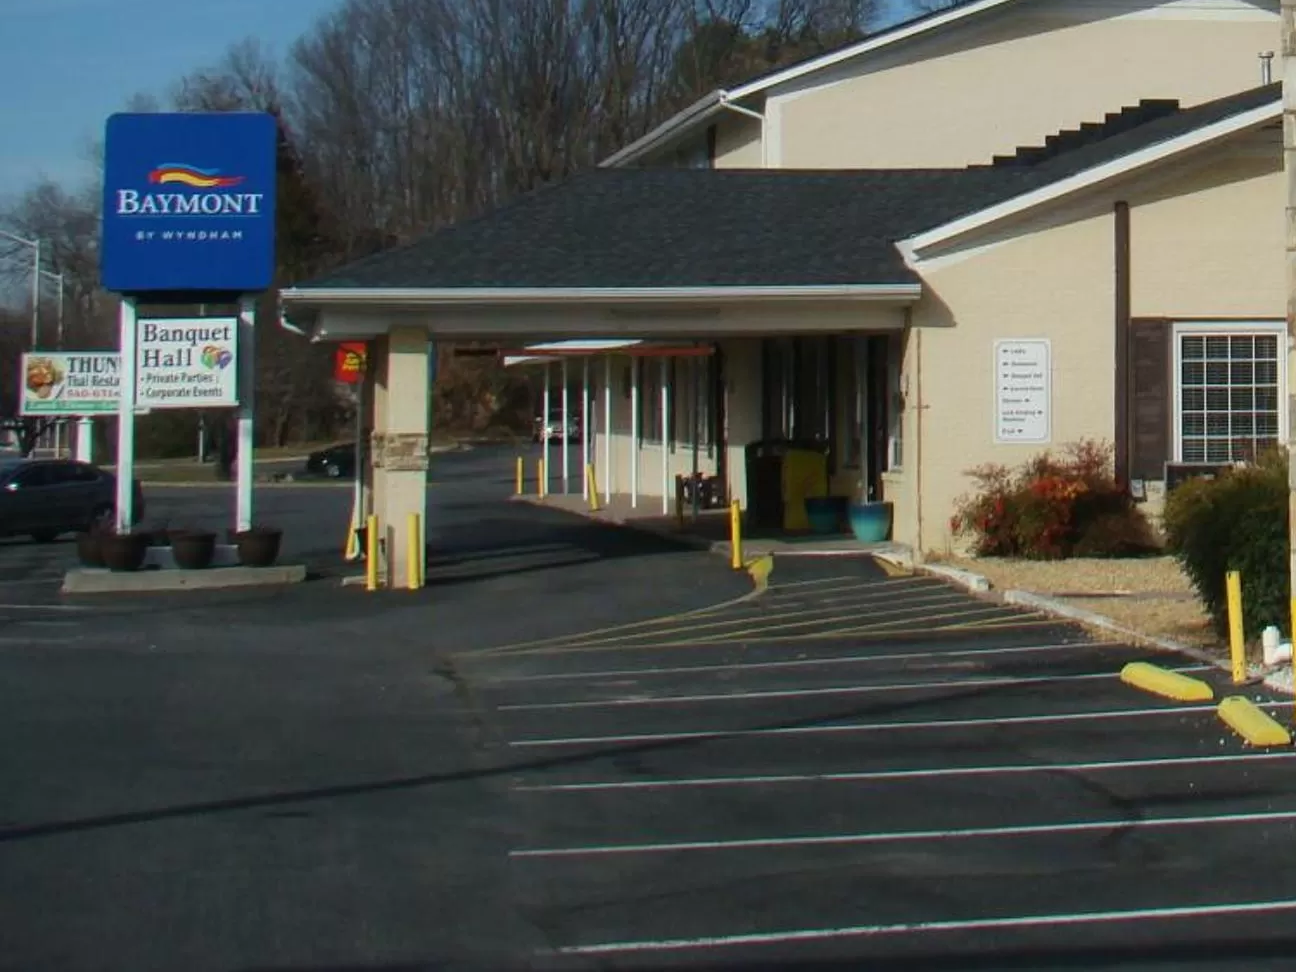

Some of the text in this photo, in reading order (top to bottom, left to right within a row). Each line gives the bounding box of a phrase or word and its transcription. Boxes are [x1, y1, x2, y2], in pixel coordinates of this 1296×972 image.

[117, 189, 263, 214] BAYMONT
[135, 230, 243, 240] BY WYNDHAM
[143, 323, 232, 346] Banquet
[142, 348, 192, 367] Hall
[146, 372, 214, 384] Private Parties
[146, 386, 222, 399] Corporate Events
